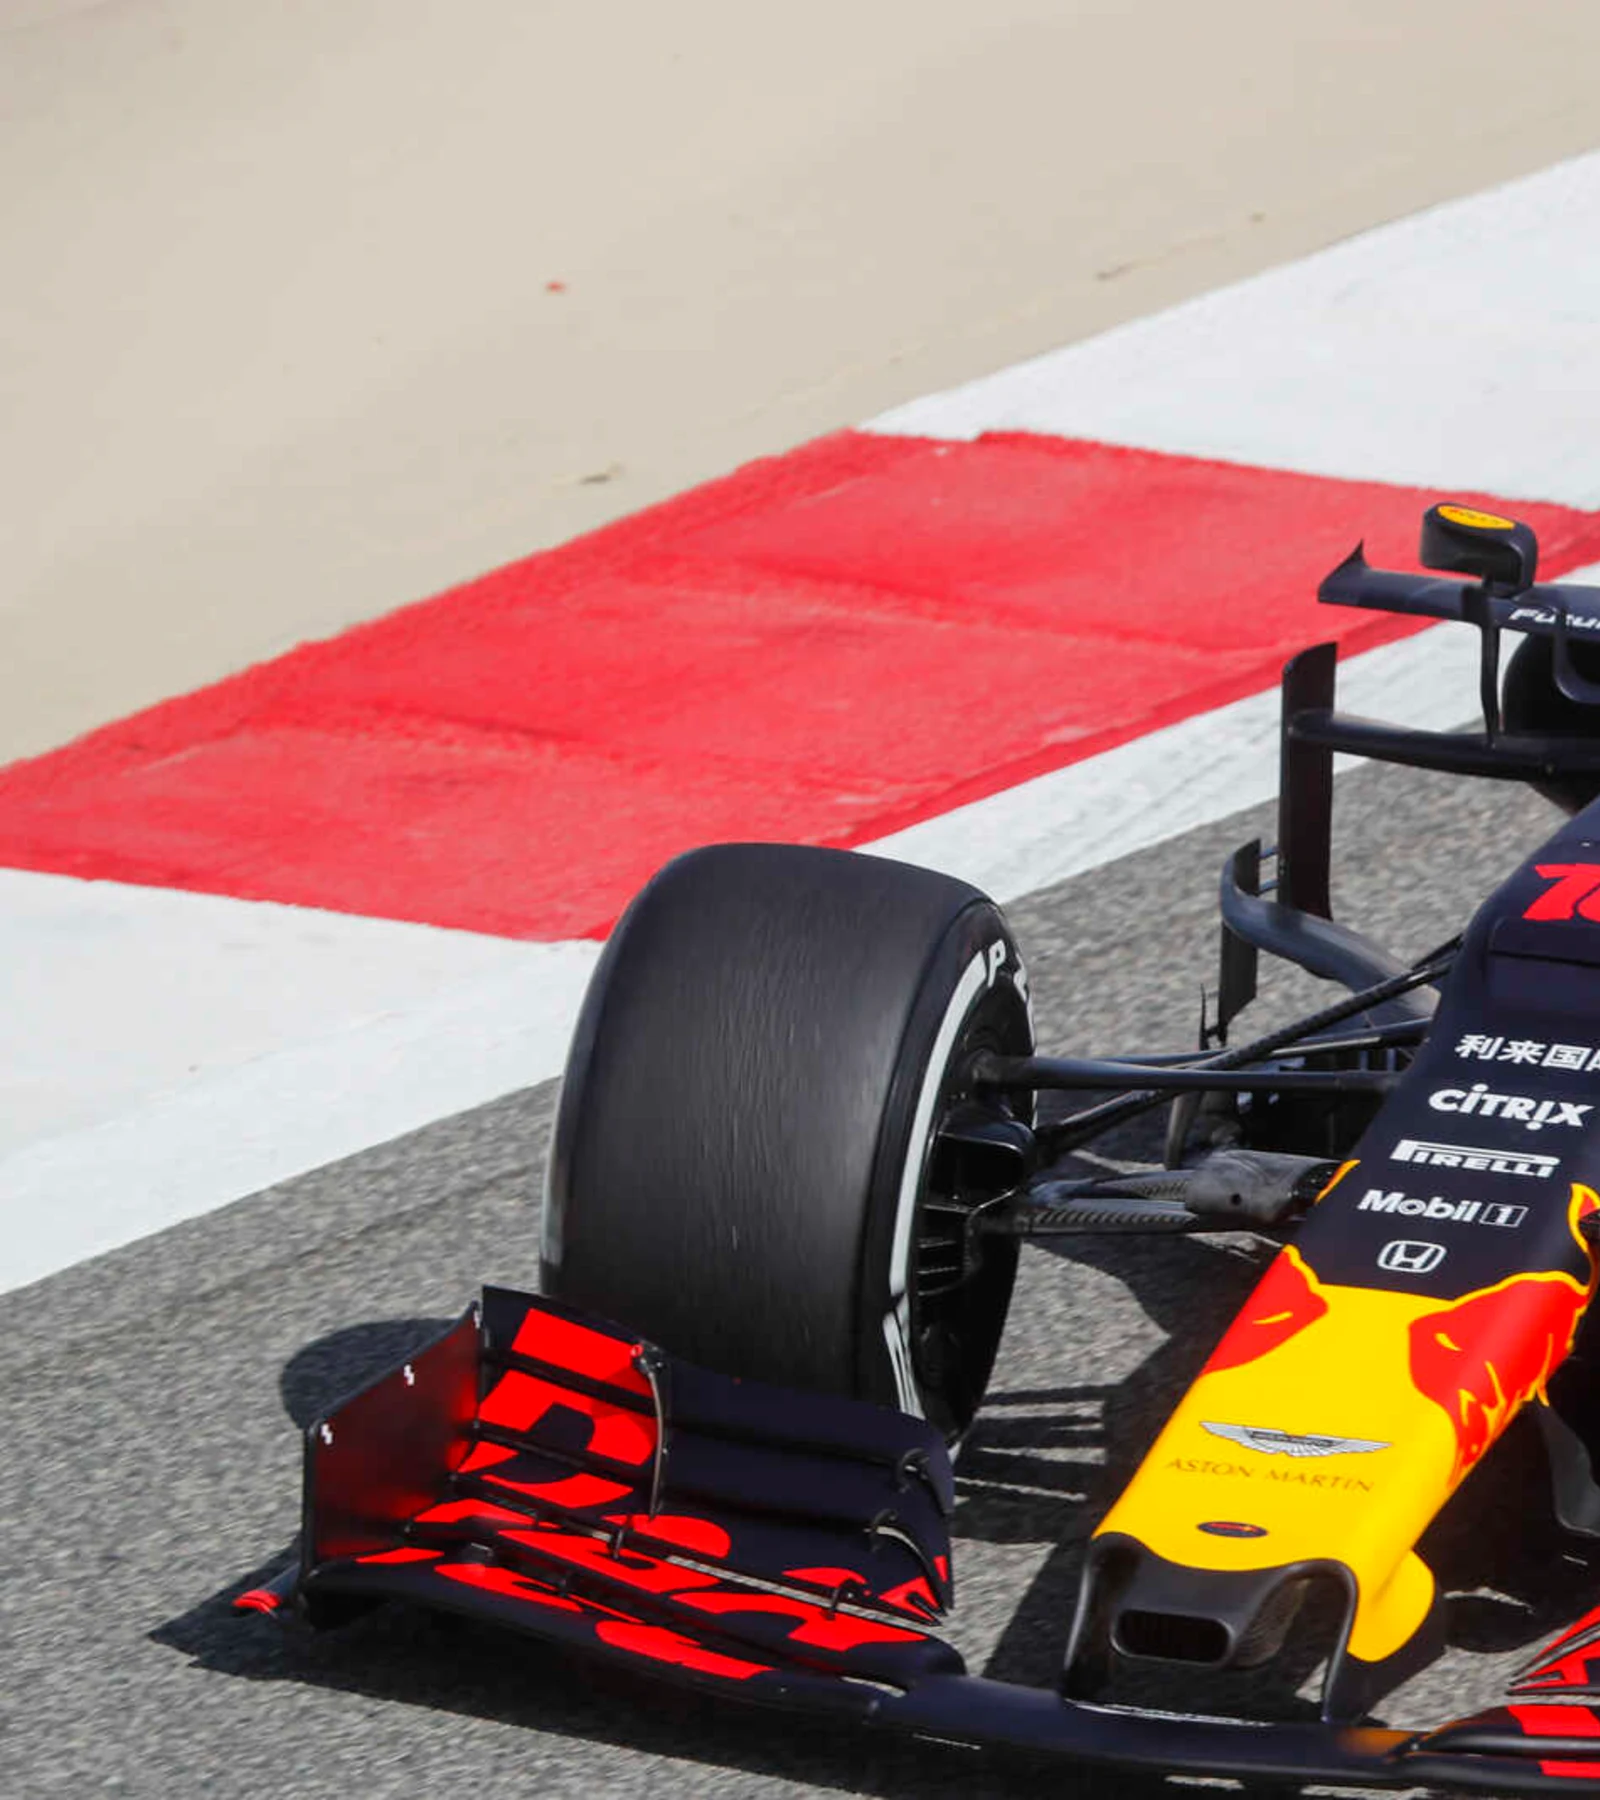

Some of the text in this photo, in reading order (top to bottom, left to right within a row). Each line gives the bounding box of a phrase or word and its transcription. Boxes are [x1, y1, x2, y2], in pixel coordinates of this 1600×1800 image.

[1390, 1139, 1560, 1178] PIRELLI
[1357, 1189, 1482, 1223] Mobil
[1166, 1457, 1375, 1492] ASTON MARTIN
